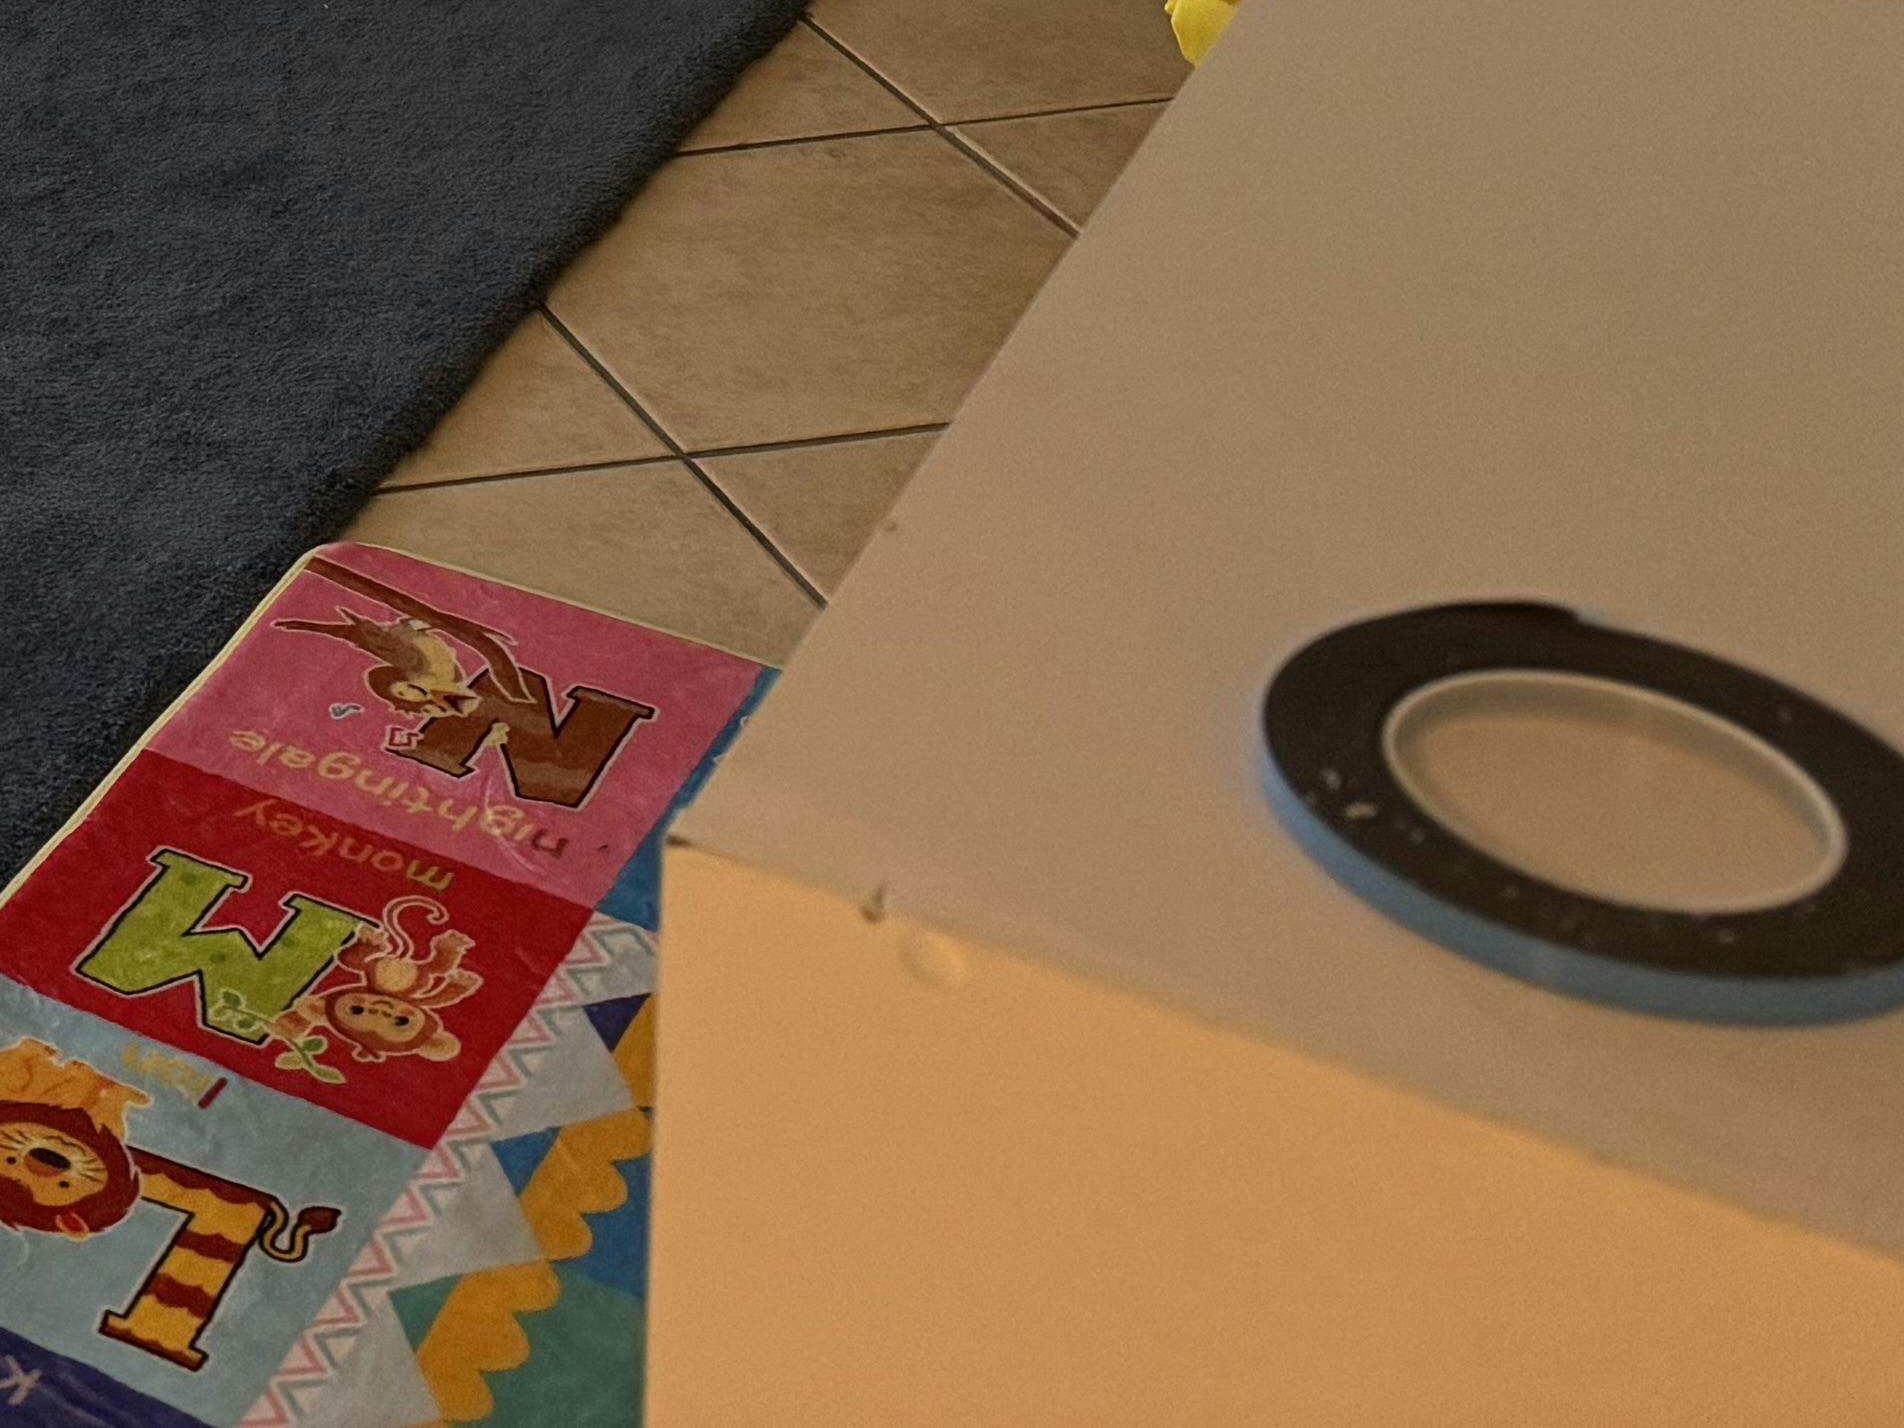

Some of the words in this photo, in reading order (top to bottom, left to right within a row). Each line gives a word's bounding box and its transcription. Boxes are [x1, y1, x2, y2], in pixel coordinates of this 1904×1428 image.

[228, 727, 569, 860] nightingale
[385, 664, 658, 809] N
[234, 798, 455, 892] monkey
[74, 846, 374, 1048] M
[98, 1142, 284, 1373] L
